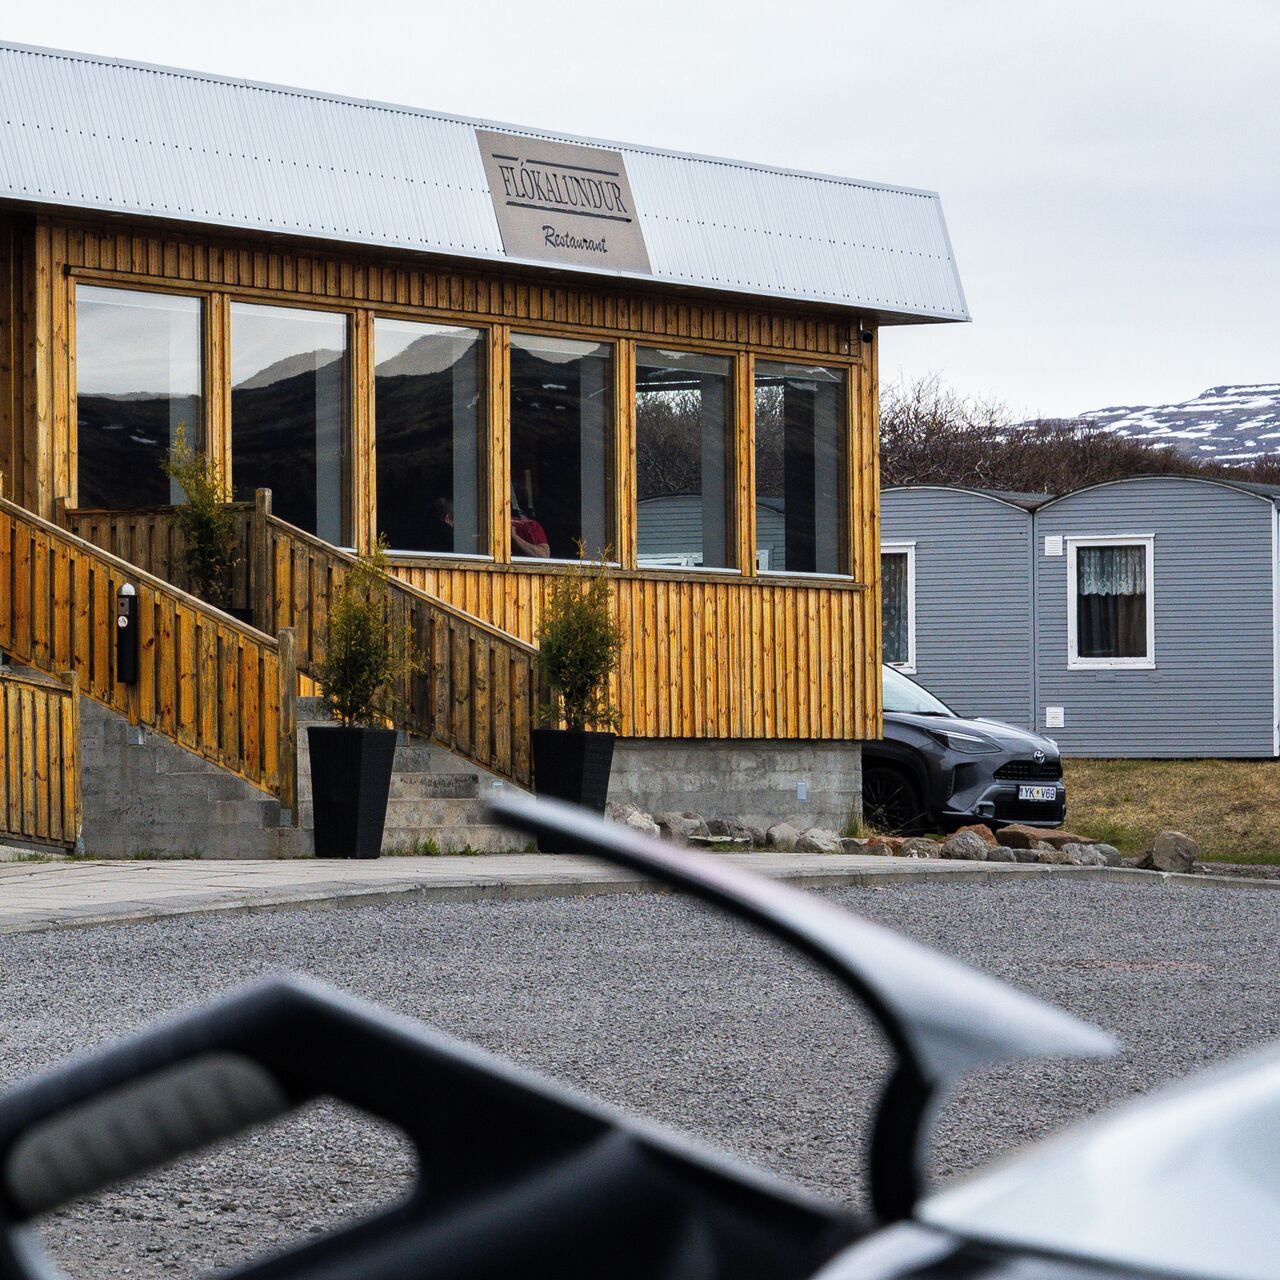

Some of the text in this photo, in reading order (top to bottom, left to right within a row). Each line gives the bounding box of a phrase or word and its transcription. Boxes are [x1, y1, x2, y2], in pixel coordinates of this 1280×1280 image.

[499, 161, 628, 213] FLÓKALUNDUR
[542, 225, 608, 253] Restaurant
[1024, 787, 1055, 799] YK V69
